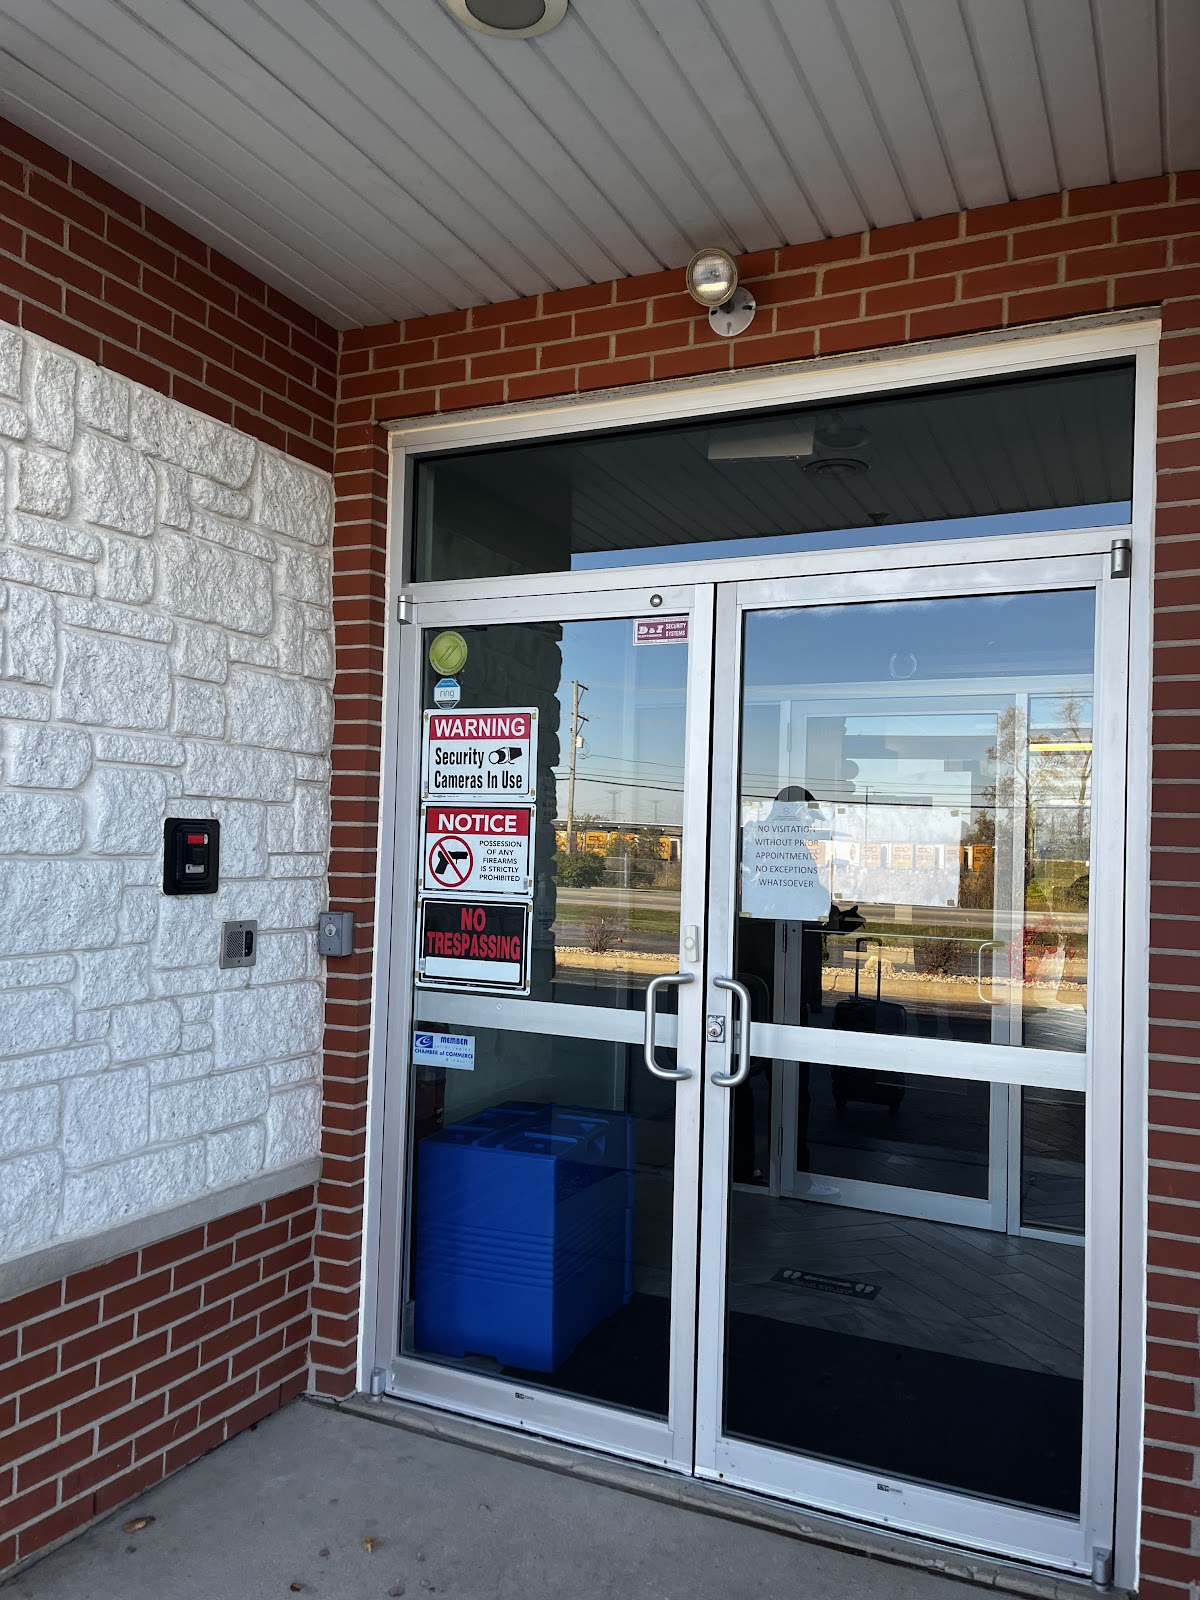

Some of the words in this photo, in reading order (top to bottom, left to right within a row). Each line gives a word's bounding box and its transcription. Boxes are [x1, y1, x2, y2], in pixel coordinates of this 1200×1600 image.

[440, 689, 454, 699] ring
[434, 717, 525, 737] WARNING
[435, 747, 484, 768] Security
[434, 770, 483, 789] Cameras
[487, 771, 498, 789] In
[502, 771, 522, 789] Use
[438, 813, 517, 833] NOTICE
[757, 825, 770, 833] NO
[771, 825, 816, 833] VISITATION
[479, 840, 522, 848] POSSESSION
[755, 838, 793, 847] WITHOUT
[795, 839, 819, 847] PRIOR
[487, 848, 497, 856] OF
[755, 851, 818, 860] APPOINTMENTS
[483, 857, 518, 865] FIREARMS
[480, 865, 487, 873] IS
[488, 866, 519, 874] STRICTLY
[755, 865, 768, 873] NO
[769, 865, 818, 874] EXCEPTIONS
[479, 874, 520, 882] PROHIBITED
[758, 878, 814, 888] WHATSOEVER
[461, 907, 486, 932] NO
[427, 931, 520, 960] TRESPASSING
[441, 1037, 468, 1045] MEMBER
[446, 1051, 473, 1059] COMMERCE
